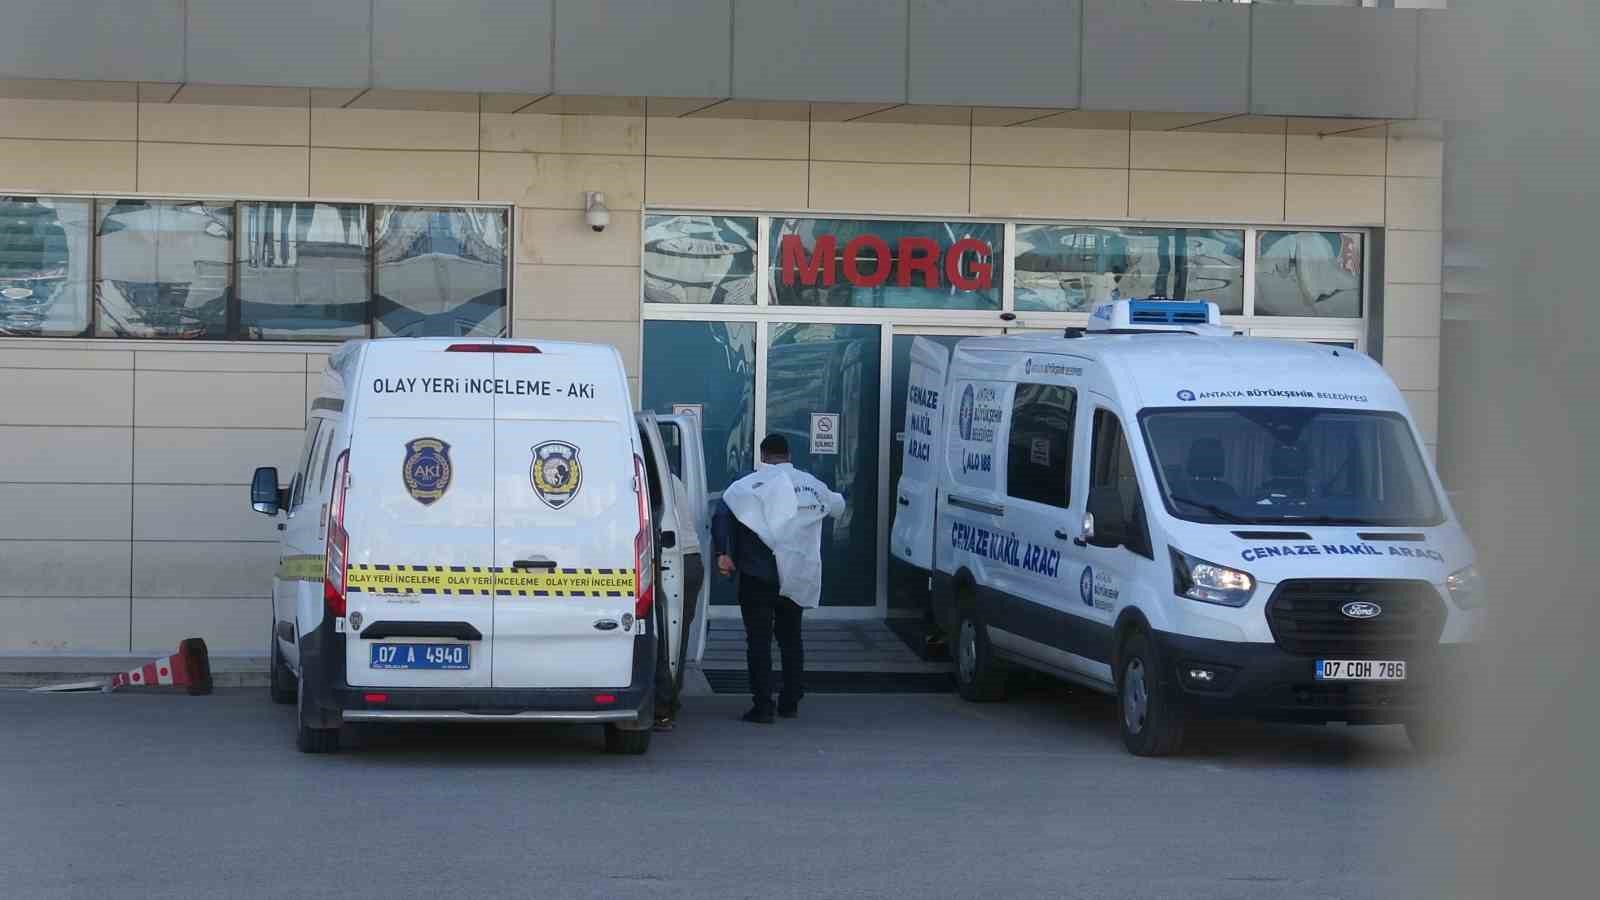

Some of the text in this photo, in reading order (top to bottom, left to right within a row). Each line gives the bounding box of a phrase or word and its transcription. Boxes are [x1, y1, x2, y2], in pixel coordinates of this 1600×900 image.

[780, 233, 994, 291] MORG
[373, 378, 417, 393] OLAY
[421, 378, 459, 393] YERİ
[464, 378, 550, 396] İNCELEME
[567, 383, 595, 399] AKİ
[909, 385, 939, 409] CENAZE
[1199, 391, 1243, 399] ANTALYA
[1247, 388, 1314, 399] BÜYÜKŞEHİR
[910, 412, 932, 436] NAKİL
[908, 439, 931, 463] ARACI
[952, 520, 1060, 578] CENAZE NAKİL ARACI
[1241, 543, 1446, 564] CENAZE NAKİL ARACI
[349, 573, 372, 583] OLAY
[374, 573, 394, 585] YERİ
[395, 573, 441, 585] İNCELEME
[447, 575, 472, 586] OLAY
[545, 576, 569, 587] OLAY
[570, 576, 590, 588] YERİ
[591, 576, 634, 589] İNCELEME
[1349, 603, 1374, 616] Ford
[379, 646, 463, 664] 07 A 4940
[1323, 661, 1341, 677] 07
[1346, 661, 1372, 678] CDH
[1378, 662, 1404, 678] 786
